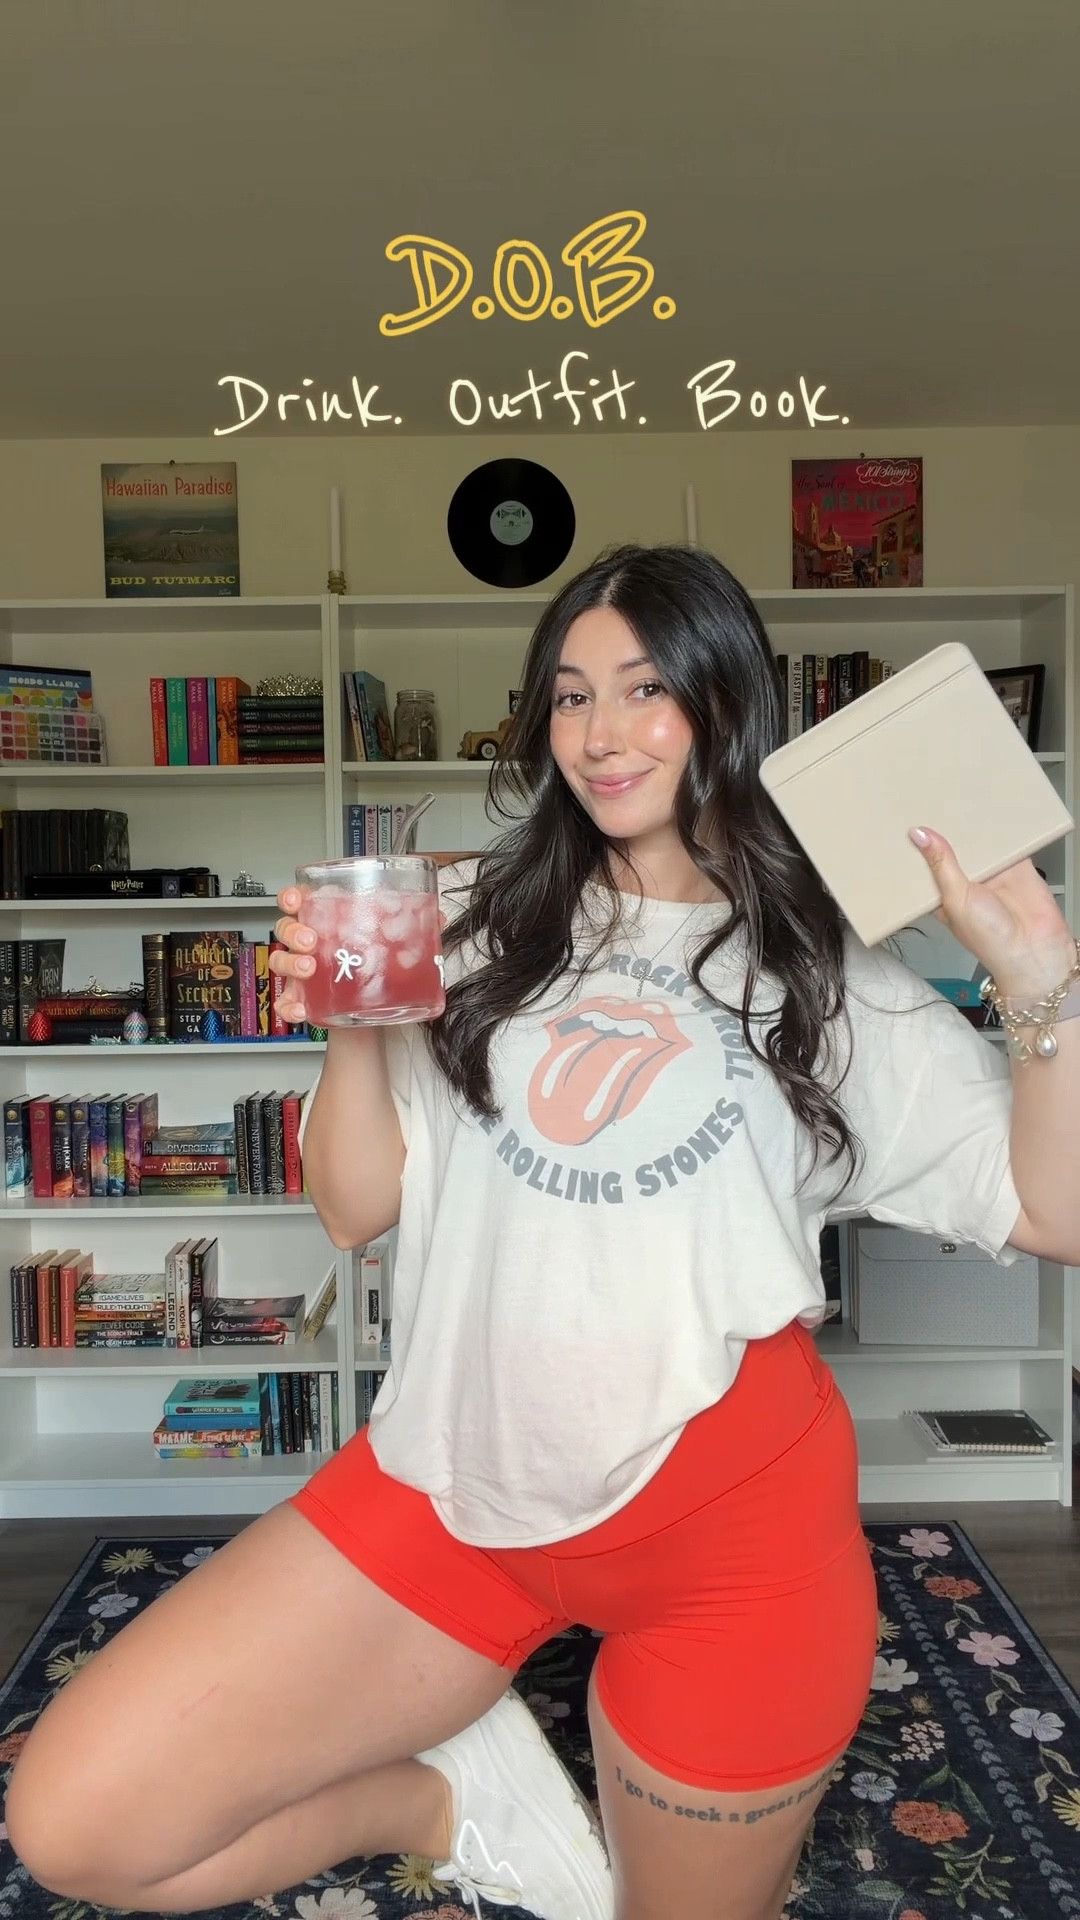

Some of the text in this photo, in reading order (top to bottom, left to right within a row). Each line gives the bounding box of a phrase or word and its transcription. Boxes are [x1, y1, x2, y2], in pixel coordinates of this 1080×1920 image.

[880, 464, 911, 482] Strings
[105, 475, 234, 497] Hawaiian Paradise
[111, 576, 236, 585] BUD TUTMARC
[793, 662, 801, 671] NO
[46, 680, 79, 689] LLAMA
[793, 673, 801, 690] EASY
[793, 691, 801, 704] DAY
[817, 688, 825, 704] SINS
[367, 816, 375, 853] FLAWLESS
[111, 879, 144, 891] Harry Potter
[175, 947, 232, 968] ALCHEMY
[42, 967, 59, 986] IRON
[197, 968, 211, 981] OF
[147, 966, 159, 1011] NARNIA
[177, 983, 232, 1003] SECRETS
[65, 1008, 83, 1016] HART
[179, 1014, 231, 1023] STEPIE
[608, 953, 754, 1081] ROCK ROLL
[167, 1144, 219, 1153] DIVERGENT
[496, 1097, 744, 1205] ROLLING STONES
[62, 1146, 70, 1171] HOUSE
[160, 1161, 219, 1172] ALLEGIANT
[251, 1129, 262, 1188] NEVER FADE
[160, 1179, 218, 1191] INSURGENT
[168, 1292, 176, 1331] LEGEND
[158, 1431, 194, 1445] MAAME
[200, 1432, 223, 1442] JESSICA
[625, 1779, 643, 1799] go
[649, 1791, 668, 1810] to
[674, 1807, 723, 1823] seek
[729, 1812, 740, 1823] a
[744, 1795, 793, 1824] great
